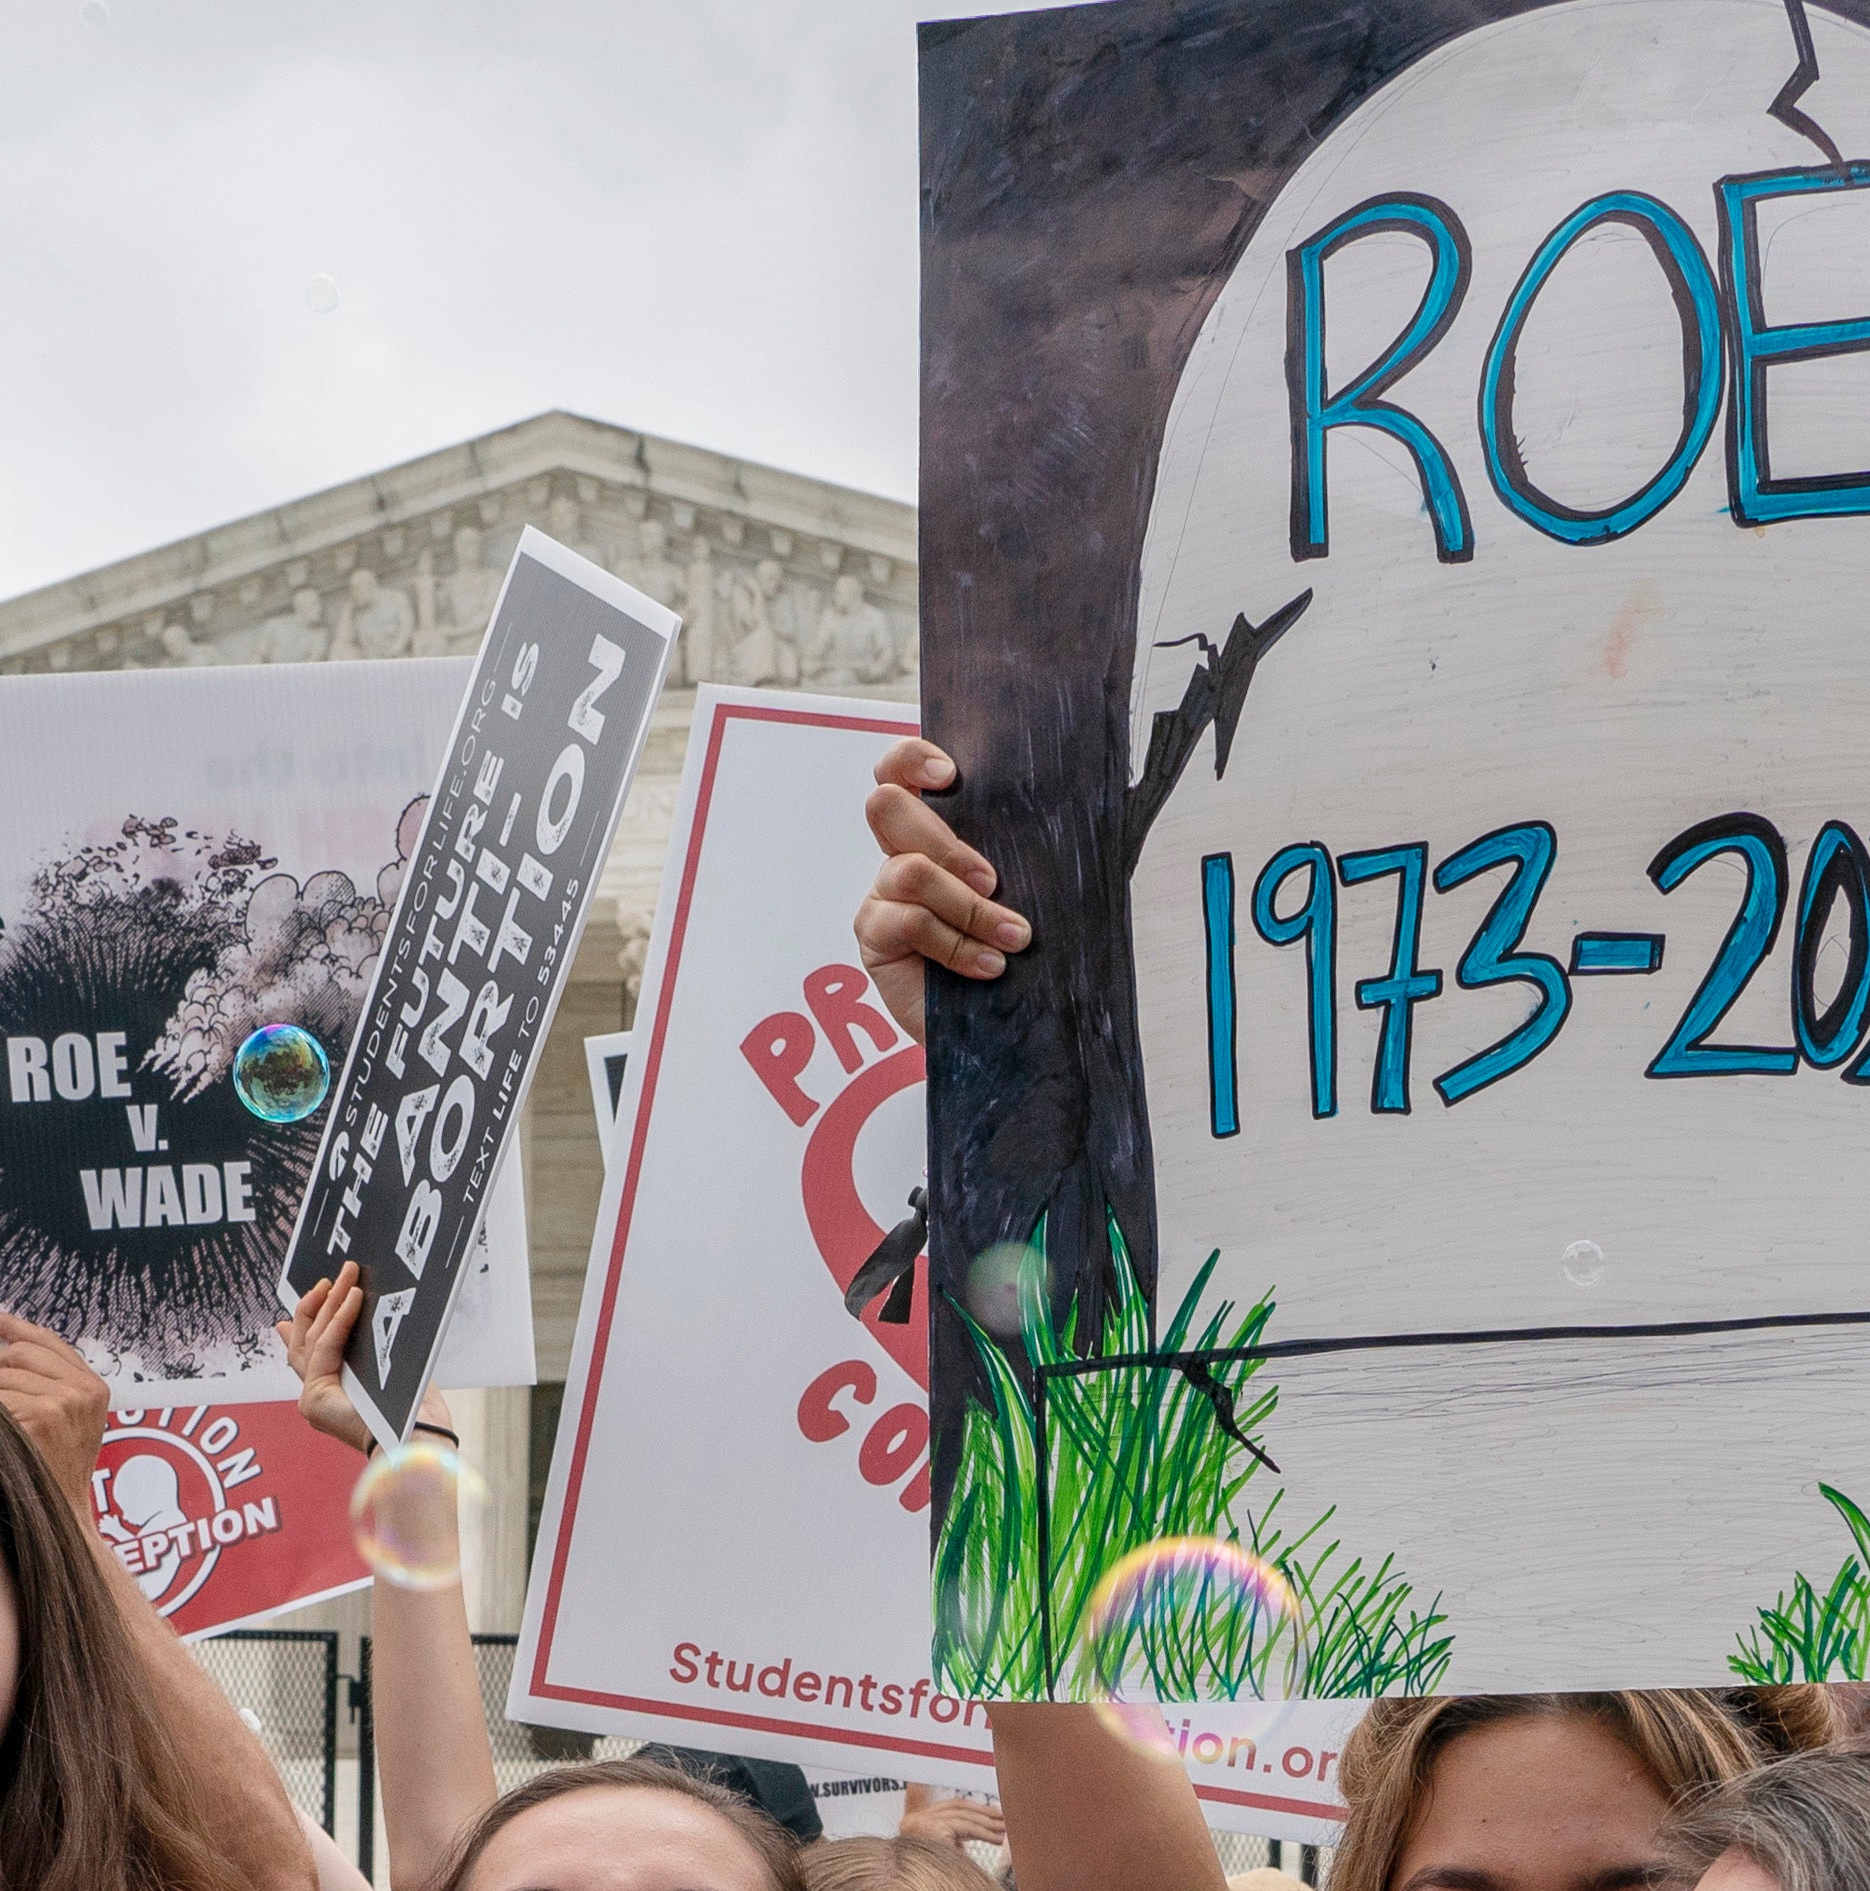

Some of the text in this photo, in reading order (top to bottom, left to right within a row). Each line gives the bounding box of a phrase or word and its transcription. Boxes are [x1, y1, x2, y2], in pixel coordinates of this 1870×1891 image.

[6, 1031, 133, 1103] ROE
[326, 641, 540, 1257] THE FUTURE IS
[345, 677, 498, 1129] STUDENTSFORLIFE.ORG
[371, 632, 627, 1391] ABORTION
[394, 791, 523, 1188] ANTI-
[463, 877, 580, 1205] TEXT LIFE TO 53445
[79, 1160, 257, 1231] WADE
[126, 1104, 169, 1153] V.
